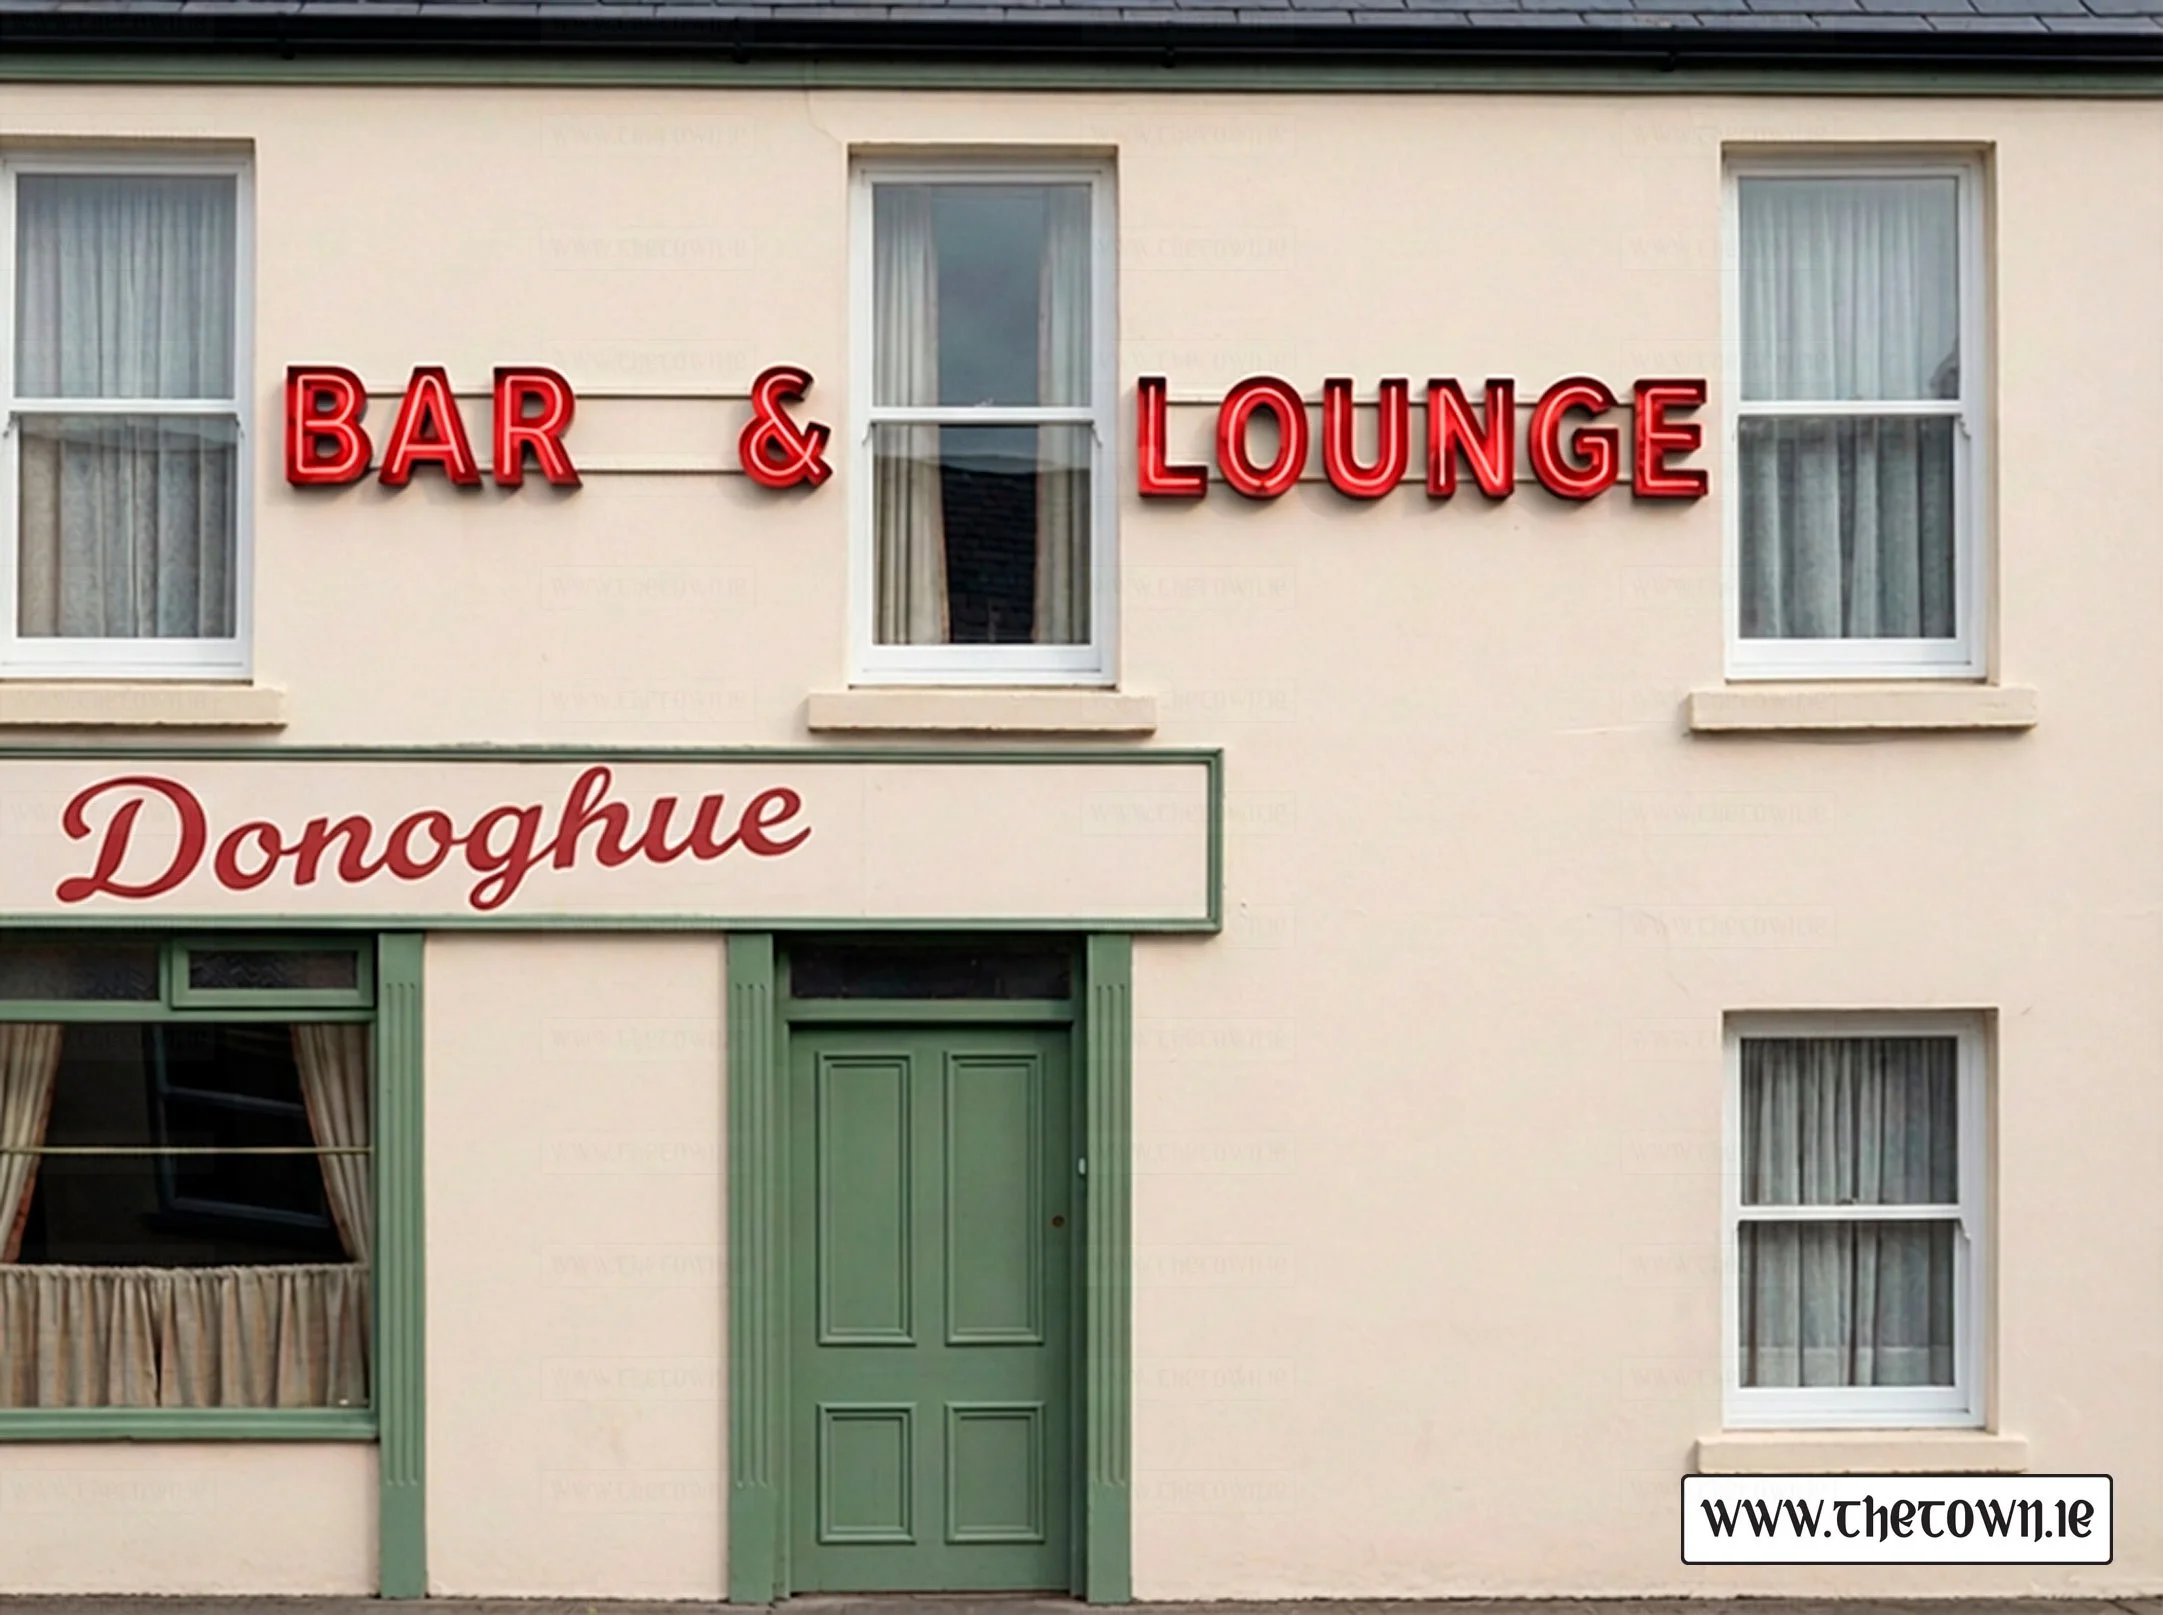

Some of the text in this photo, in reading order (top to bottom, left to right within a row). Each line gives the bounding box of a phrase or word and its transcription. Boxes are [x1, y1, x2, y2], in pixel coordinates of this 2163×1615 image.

[285, 365, 1708, 498] BAR & LOUNGE
[56, 765, 811, 910] Donoghue
